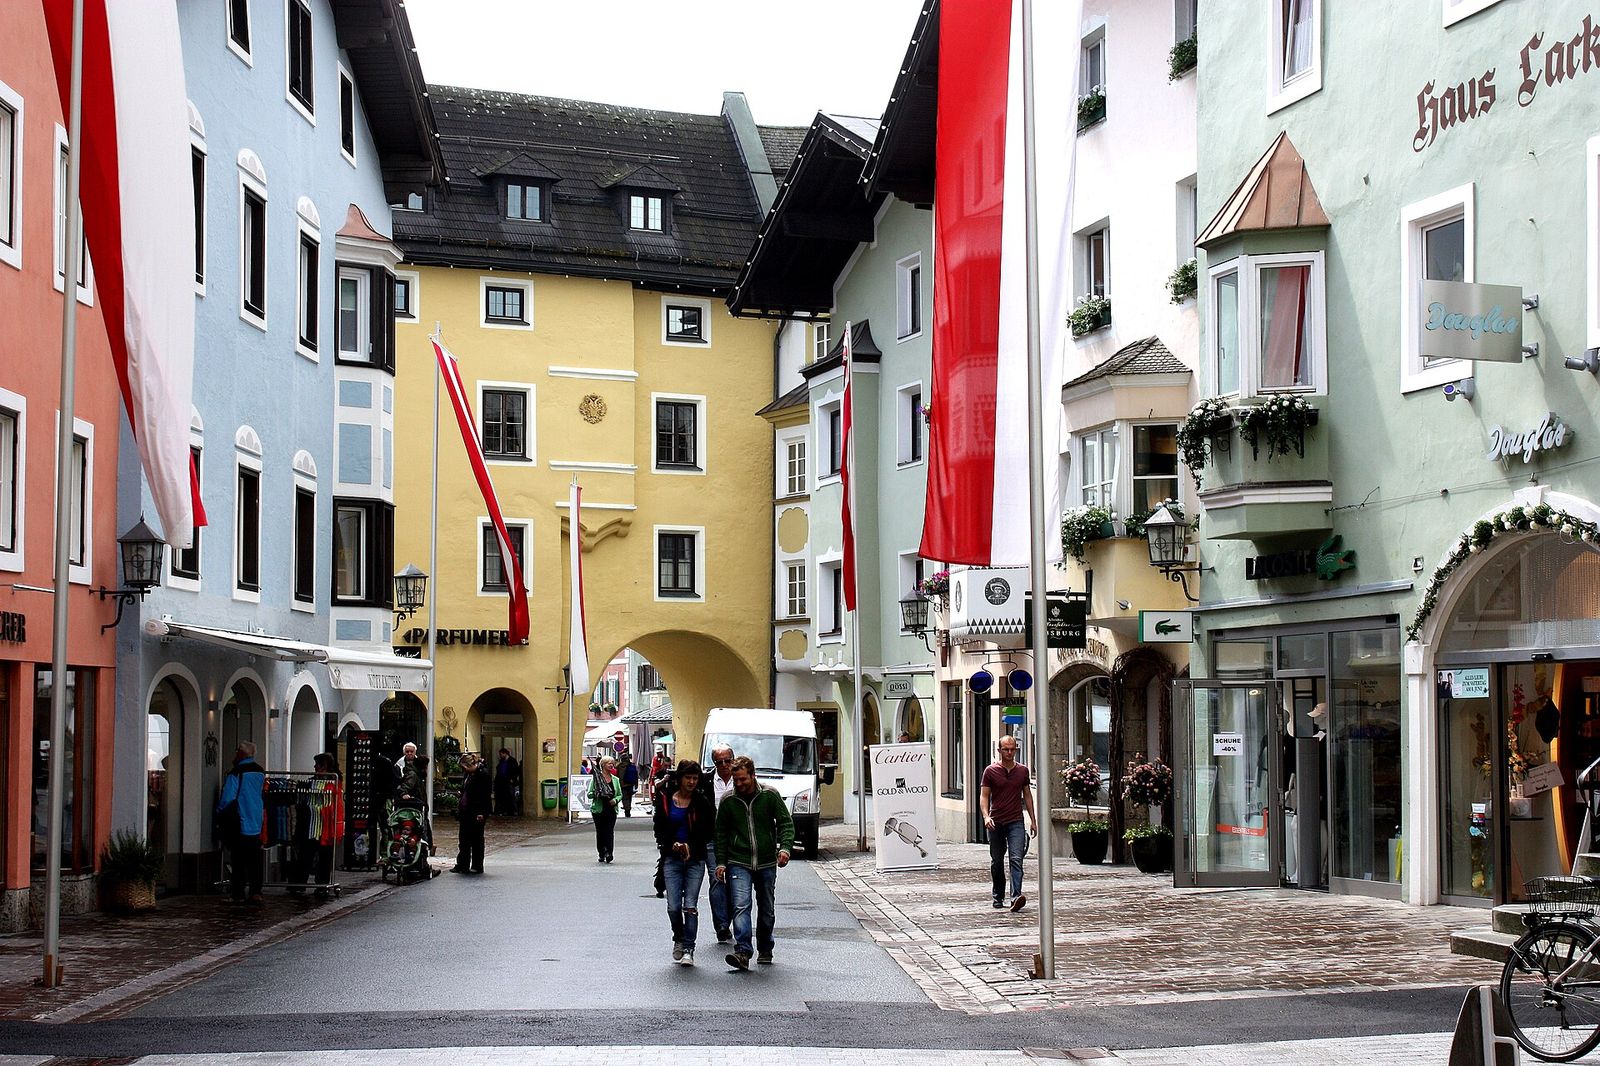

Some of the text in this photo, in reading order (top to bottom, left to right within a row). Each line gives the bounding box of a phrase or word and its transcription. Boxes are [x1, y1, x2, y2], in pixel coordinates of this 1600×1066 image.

[1412, 14, 1600, 152] Haus Lack
[1425, 301, 1519, 340] Douglas
[1486, 411, 1566, 464] Douglas
[875, 749, 927, 765] Cartier
[877, 787, 897, 796] GOLD
[904, 785, 929, 794] WOOD
